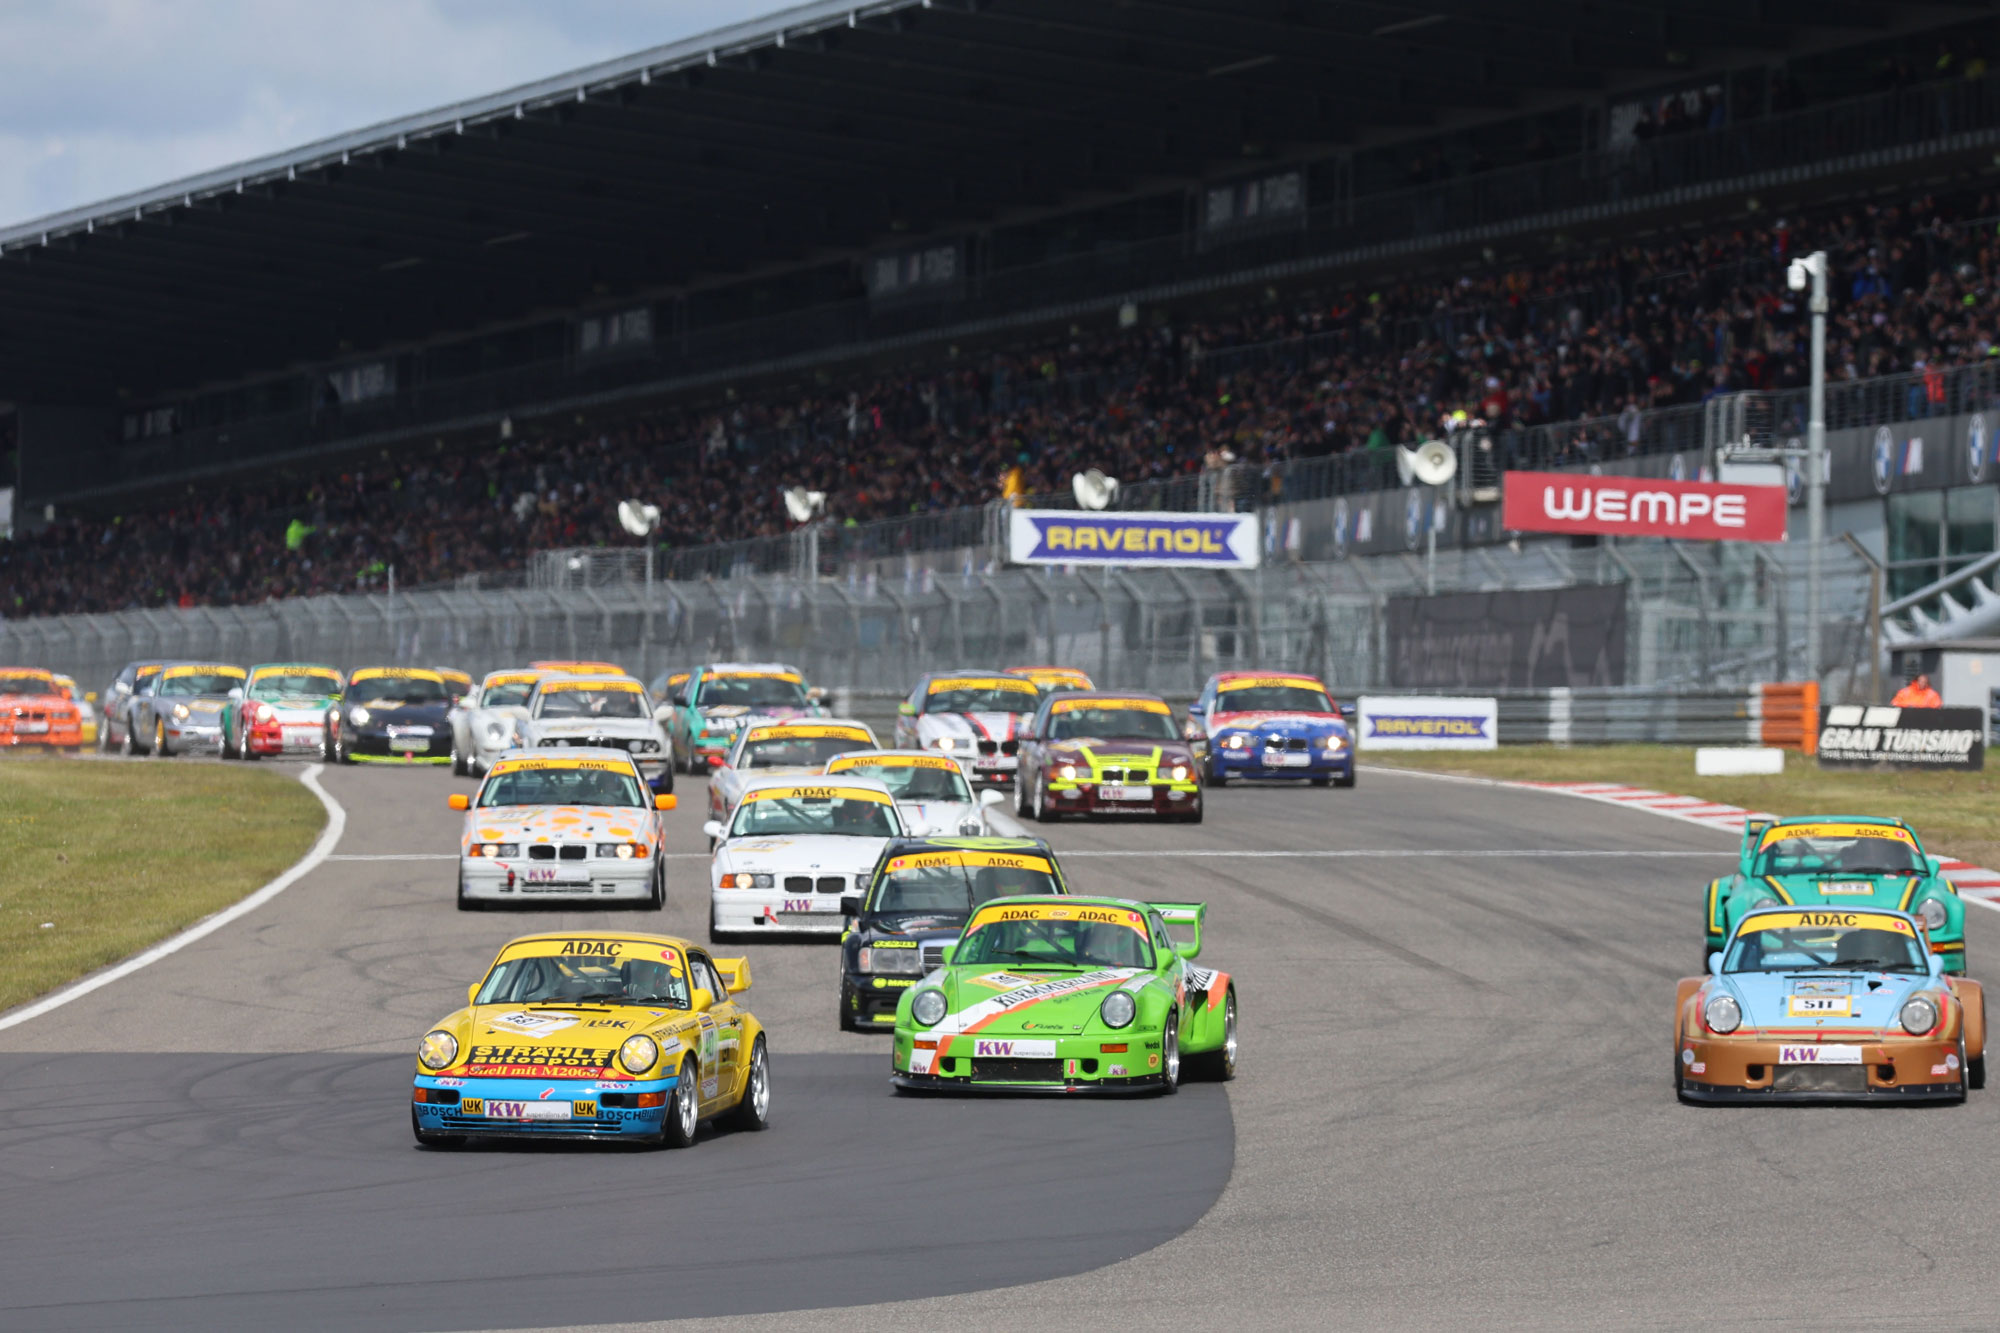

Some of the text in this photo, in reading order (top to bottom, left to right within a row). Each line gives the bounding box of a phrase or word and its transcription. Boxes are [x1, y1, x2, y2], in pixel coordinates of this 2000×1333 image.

[1543, 485, 1747, 528] WEMPE
[1046, 525, 1223, 553] RAVENOL
[1375, 719, 1480, 735] RAVENOL
[1819, 727, 1974, 753] GRAN TURISMO
[792, 787, 838, 798] ADAC
[1854, 829, 1889, 838] ADAC
[914, 857, 1024, 868] ADAC ADAC
[784, 900, 813, 912] KW
[1000, 909, 1040, 921] ADAC
[1077, 910, 1118, 923] ADAC
[1799, 914, 1858, 926] ADAC
[561, 941, 623, 956] ADAC
[978, 1041, 1015, 1055] KW
[1783, 1047, 1820, 1061] KW
[472, 1054, 605, 1067] autosport
[510, 1066, 537, 1076] mit
[422, 1105, 463, 1117] BOSCH
[489, 1102, 527, 1117] KW
[596, 1109, 641, 1121] BOSCH
